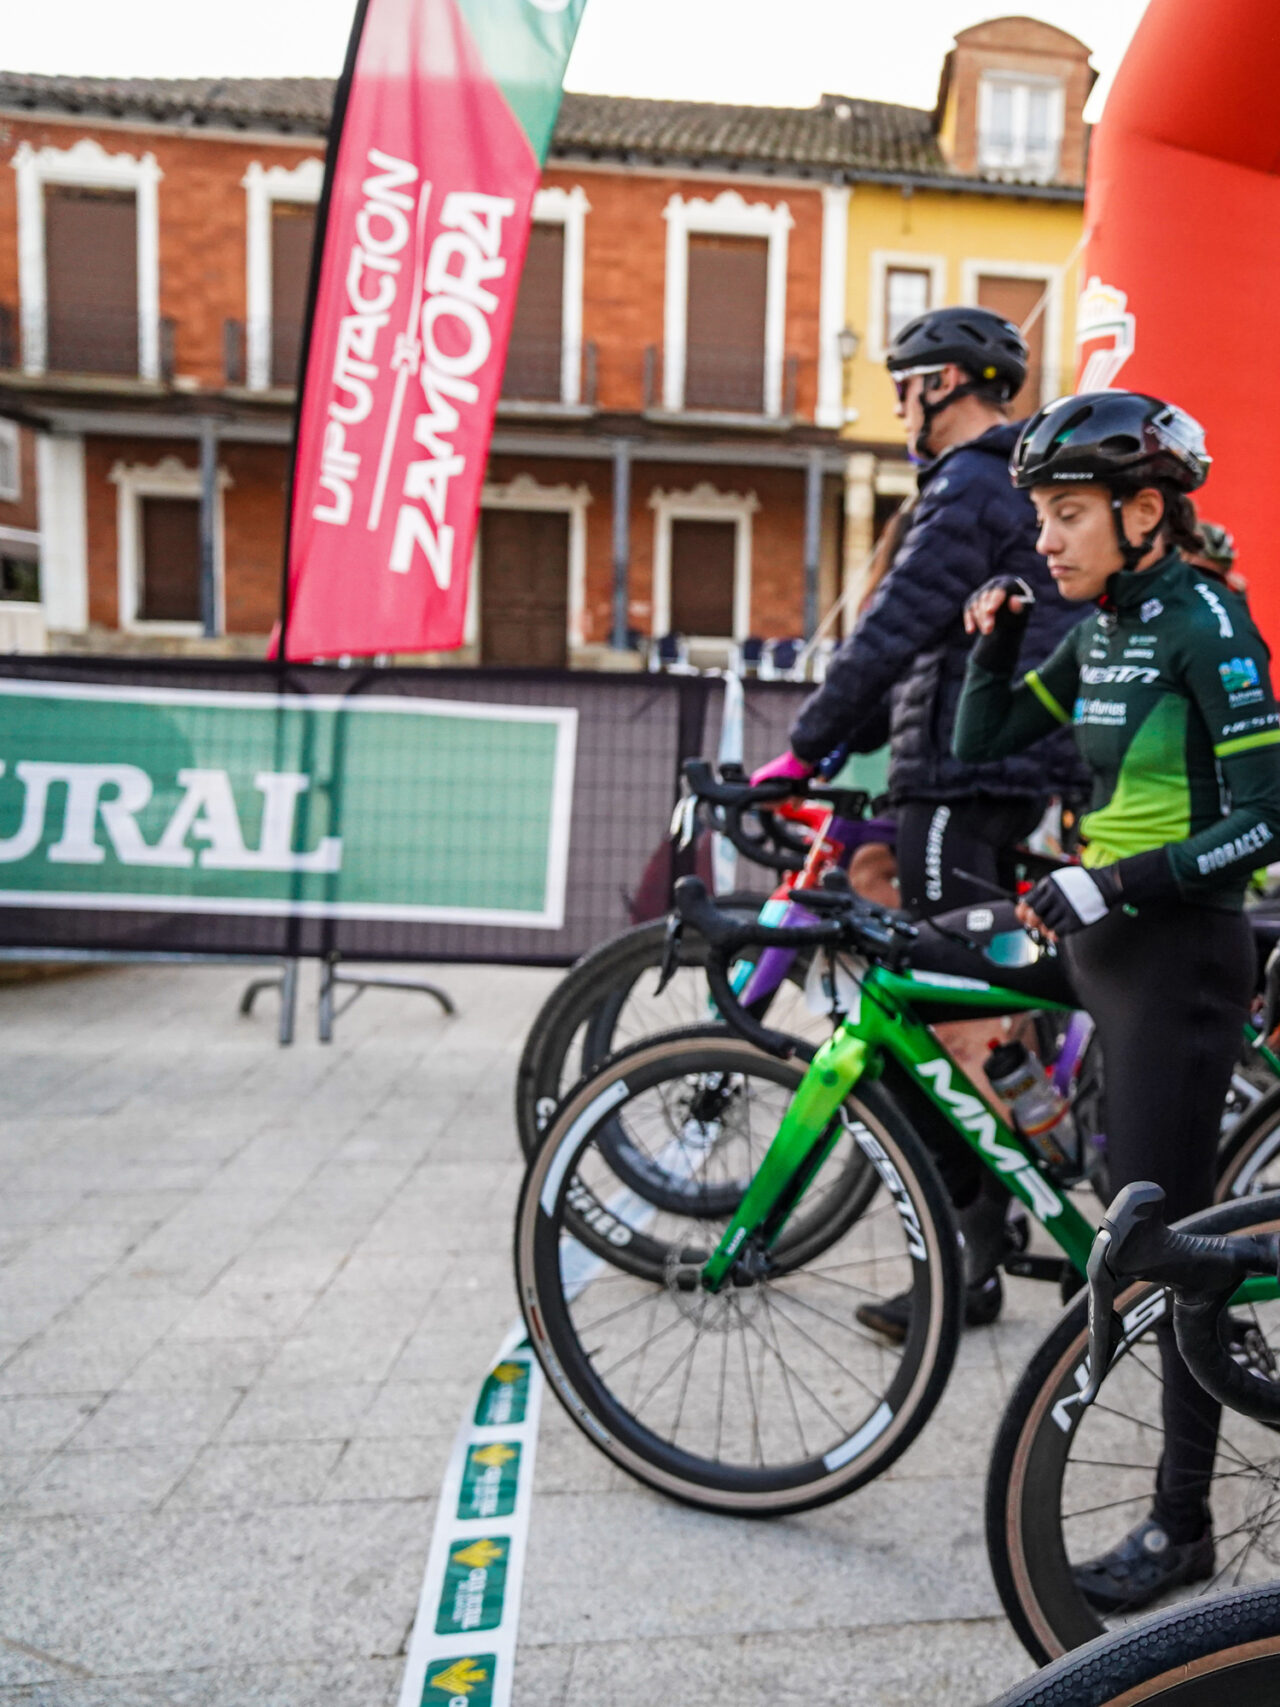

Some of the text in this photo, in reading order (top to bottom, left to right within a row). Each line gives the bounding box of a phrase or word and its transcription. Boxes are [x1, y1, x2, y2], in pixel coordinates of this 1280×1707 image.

[388, 191, 516, 590] ZAMORA
[1196, 821, 1274, 876] BIORACER
[915, 1057, 1064, 1222] MMR
